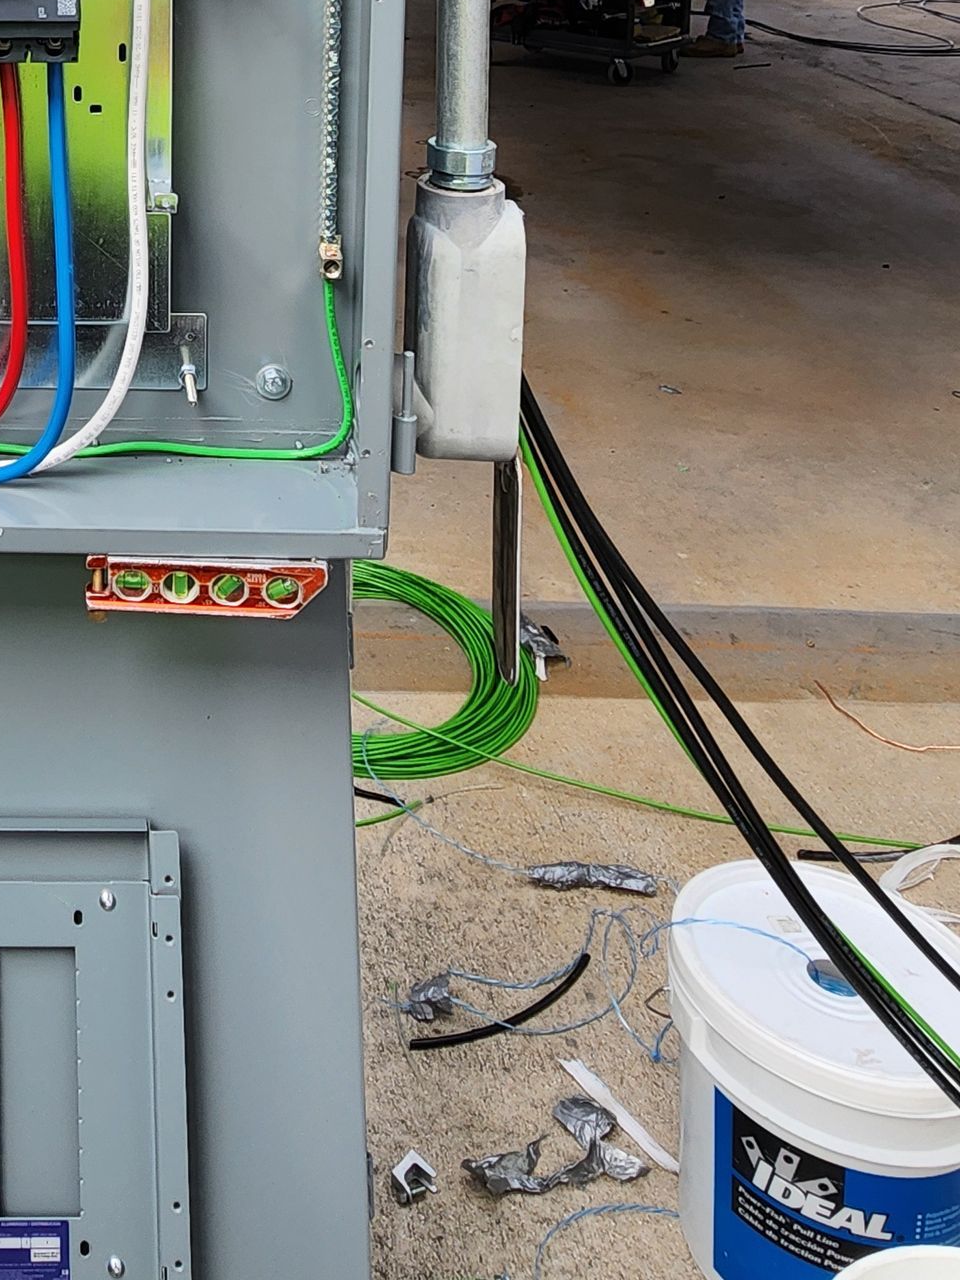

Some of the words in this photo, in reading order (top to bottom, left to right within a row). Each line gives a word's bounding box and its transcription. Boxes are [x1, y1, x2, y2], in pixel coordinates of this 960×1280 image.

[737, 1196, 765, 1221] Cable
[765, 1218, 780, 1231] de
[752, 1158, 893, 1241] IDEAL
[765, 1228, 780, 1241] de
[780, 1238, 822, 1264] traction
[793, 1223, 814, 1238] Pull
[816, 1234, 840, 1249] Line
